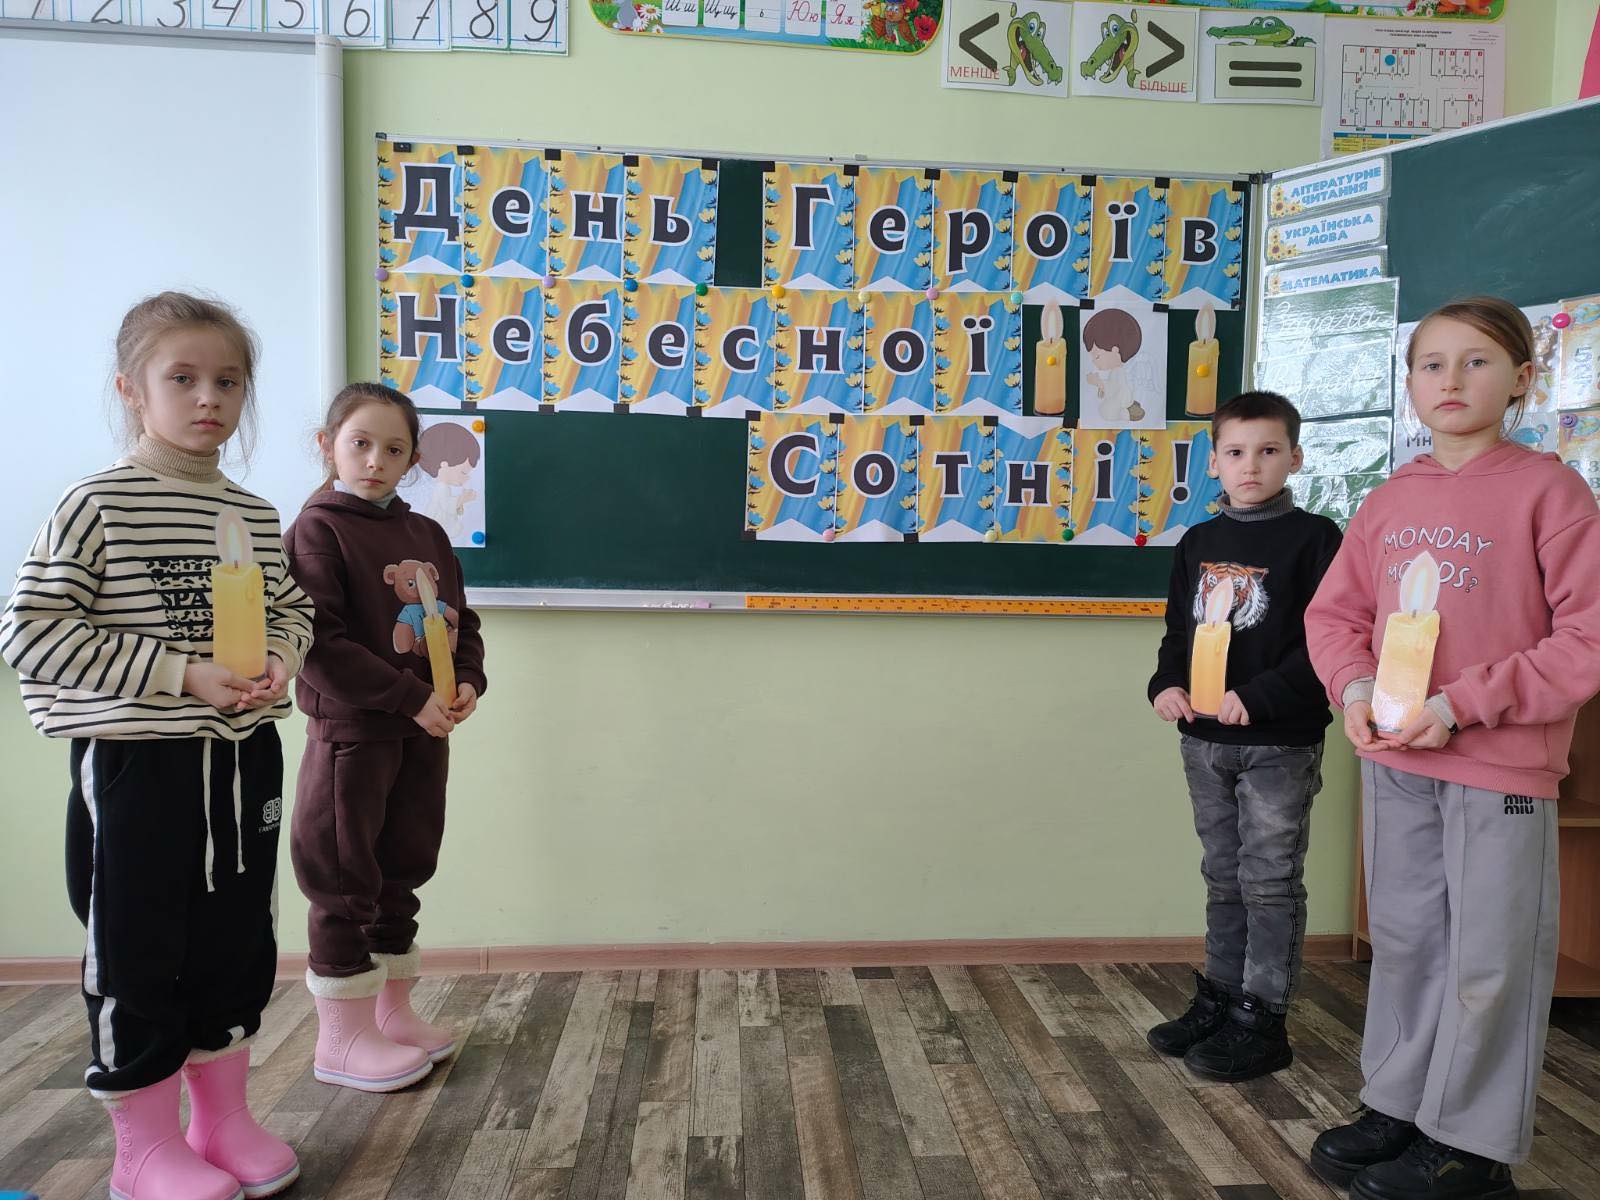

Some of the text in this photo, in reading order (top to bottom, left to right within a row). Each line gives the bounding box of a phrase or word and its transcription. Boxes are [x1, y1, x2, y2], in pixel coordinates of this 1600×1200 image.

[344, 0, 370, 37] 6
[412, 0, 435, 40] 7
[470, 0, 499, 38] 8
[524, 0, 557, 42] 9
[949, 65, 1000, 80] МЕНШЕ
[1139, 79, 1188, 93] БІЛЬШЕ
[1290, 166, 1382, 199] ЛІТЕРАТУРНЕ
[1301, 181, 1369, 205] ЧИТАННЯ
[392, 163, 1219, 275] День Героїв
[1285, 213, 1374, 240] УКРАЇНСЬКА
[1307, 229, 1348, 247] МОВА
[1280, 266, 1380, 291] МАТЕМАТИКА
[395, 292, 993, 376] Небесної
[767, 432, 1194, 506] Сотні!
[1384, 526, 1492, 555] MONDAY
